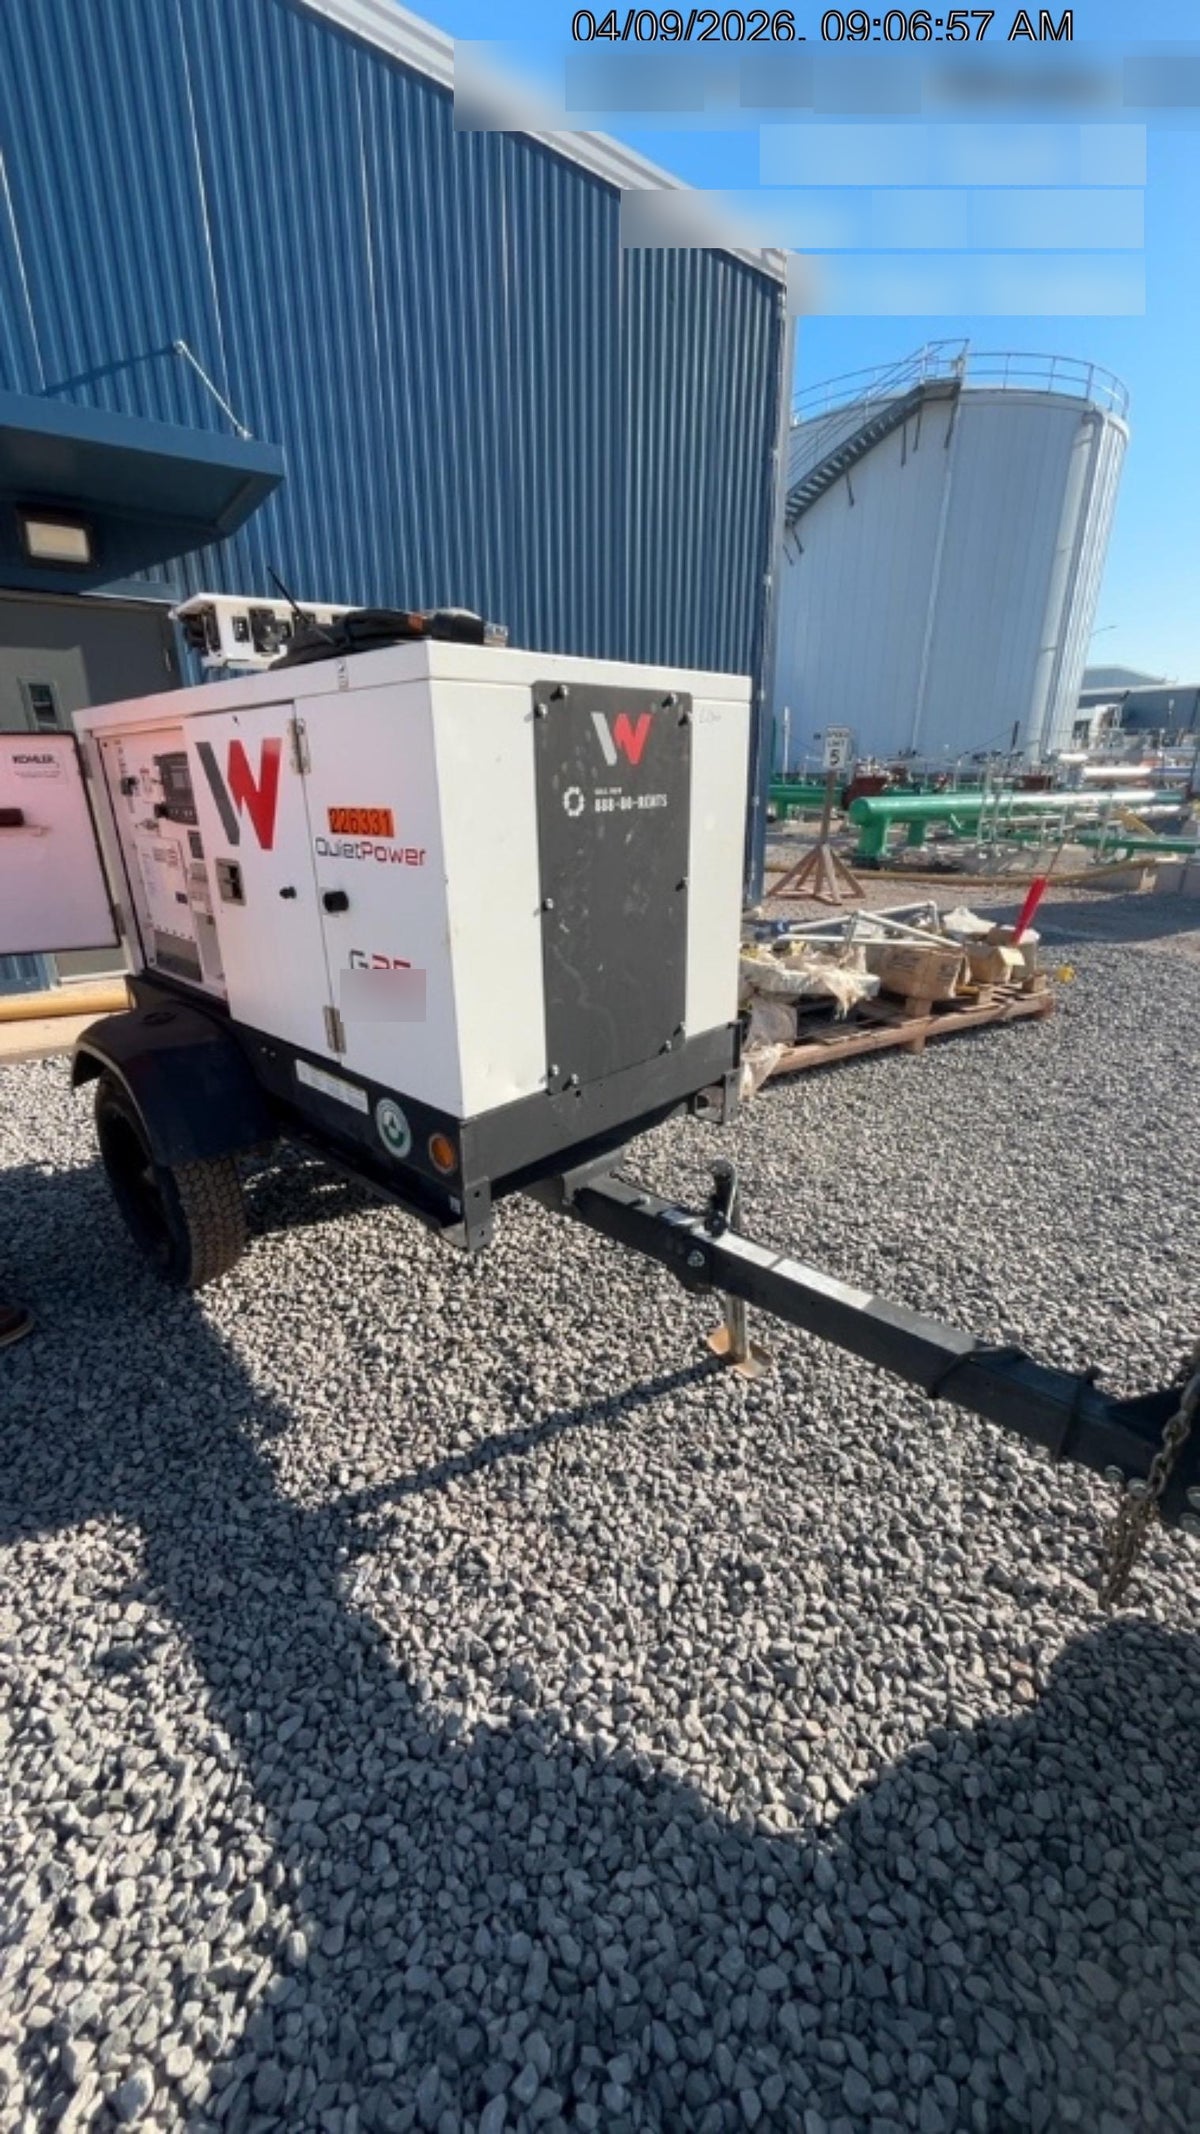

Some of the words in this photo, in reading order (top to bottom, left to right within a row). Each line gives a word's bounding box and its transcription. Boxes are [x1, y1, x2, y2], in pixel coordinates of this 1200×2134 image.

[830, 748, 840, 767] 5
[329, 808, 394, 838] 226331
[315, 836, 426, 867] QuietPower
